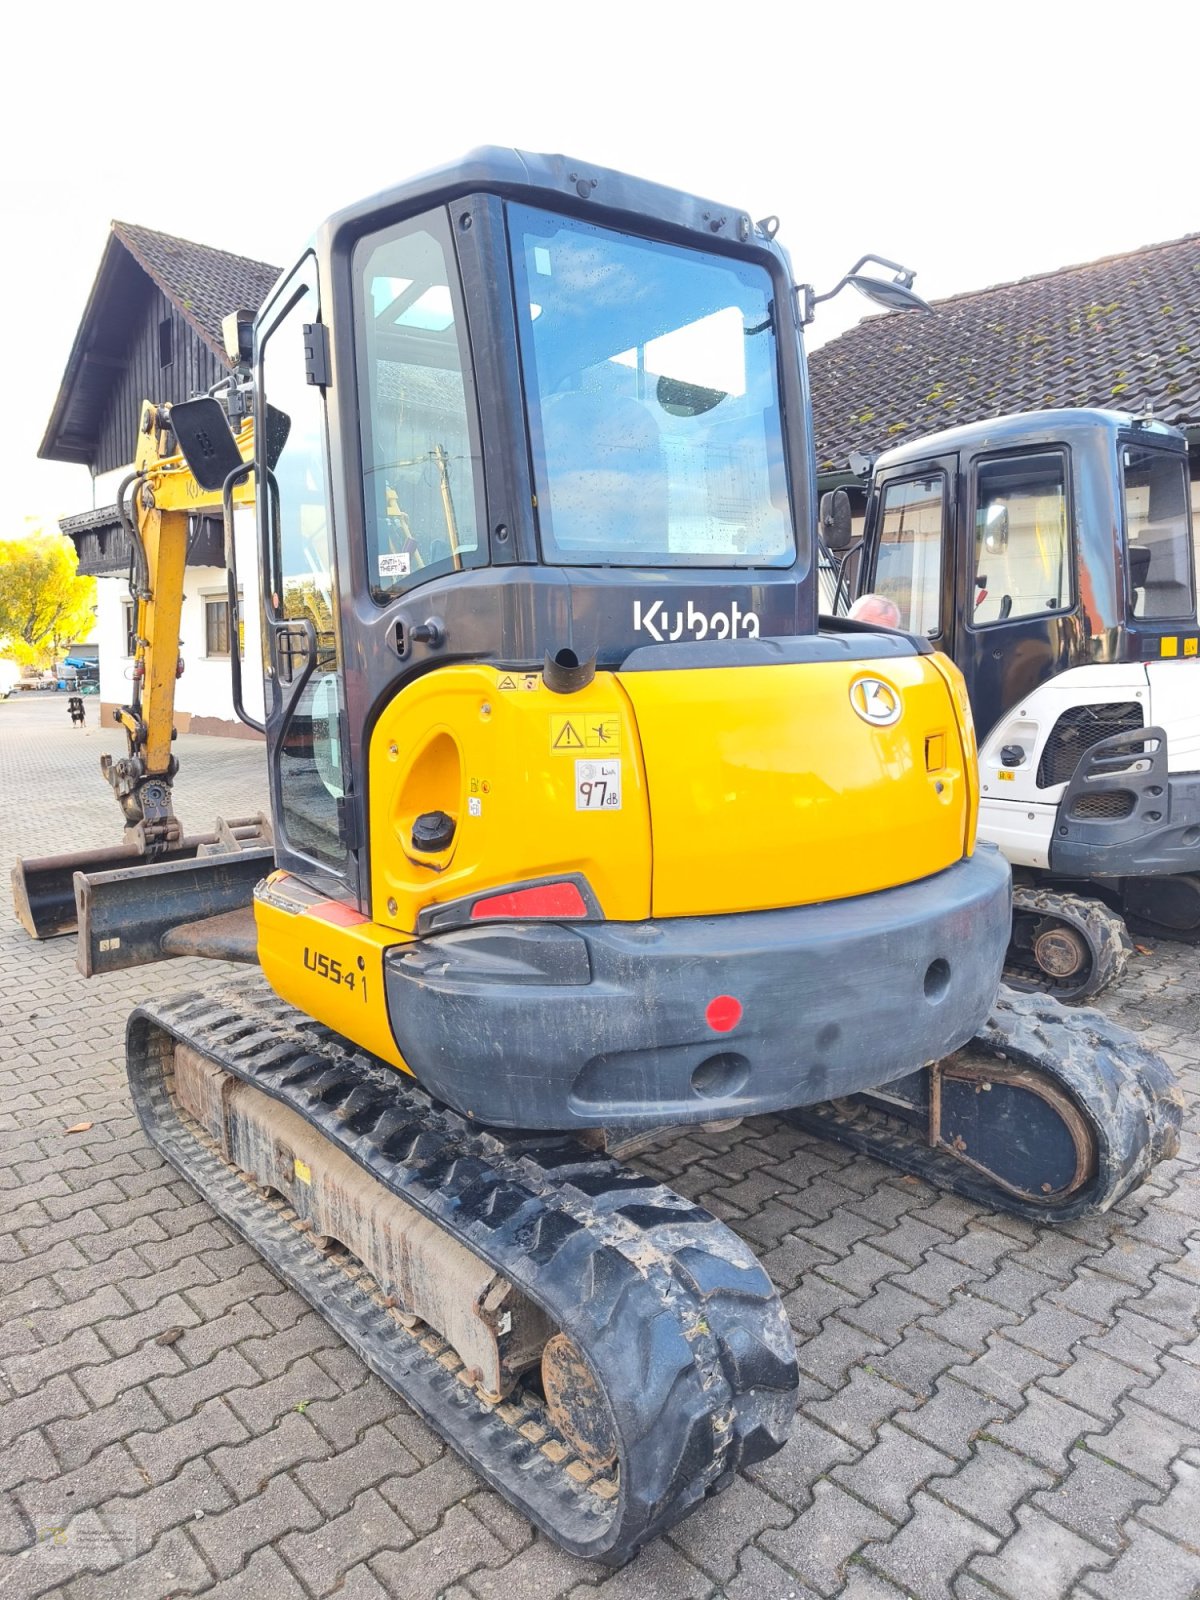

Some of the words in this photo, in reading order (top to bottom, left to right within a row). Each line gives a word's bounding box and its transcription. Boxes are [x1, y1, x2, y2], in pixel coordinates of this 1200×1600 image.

[634, 601, 760, 641] Kubota
[580, 782, 607, 806] 97
[606, 793, 618, 805] dB
